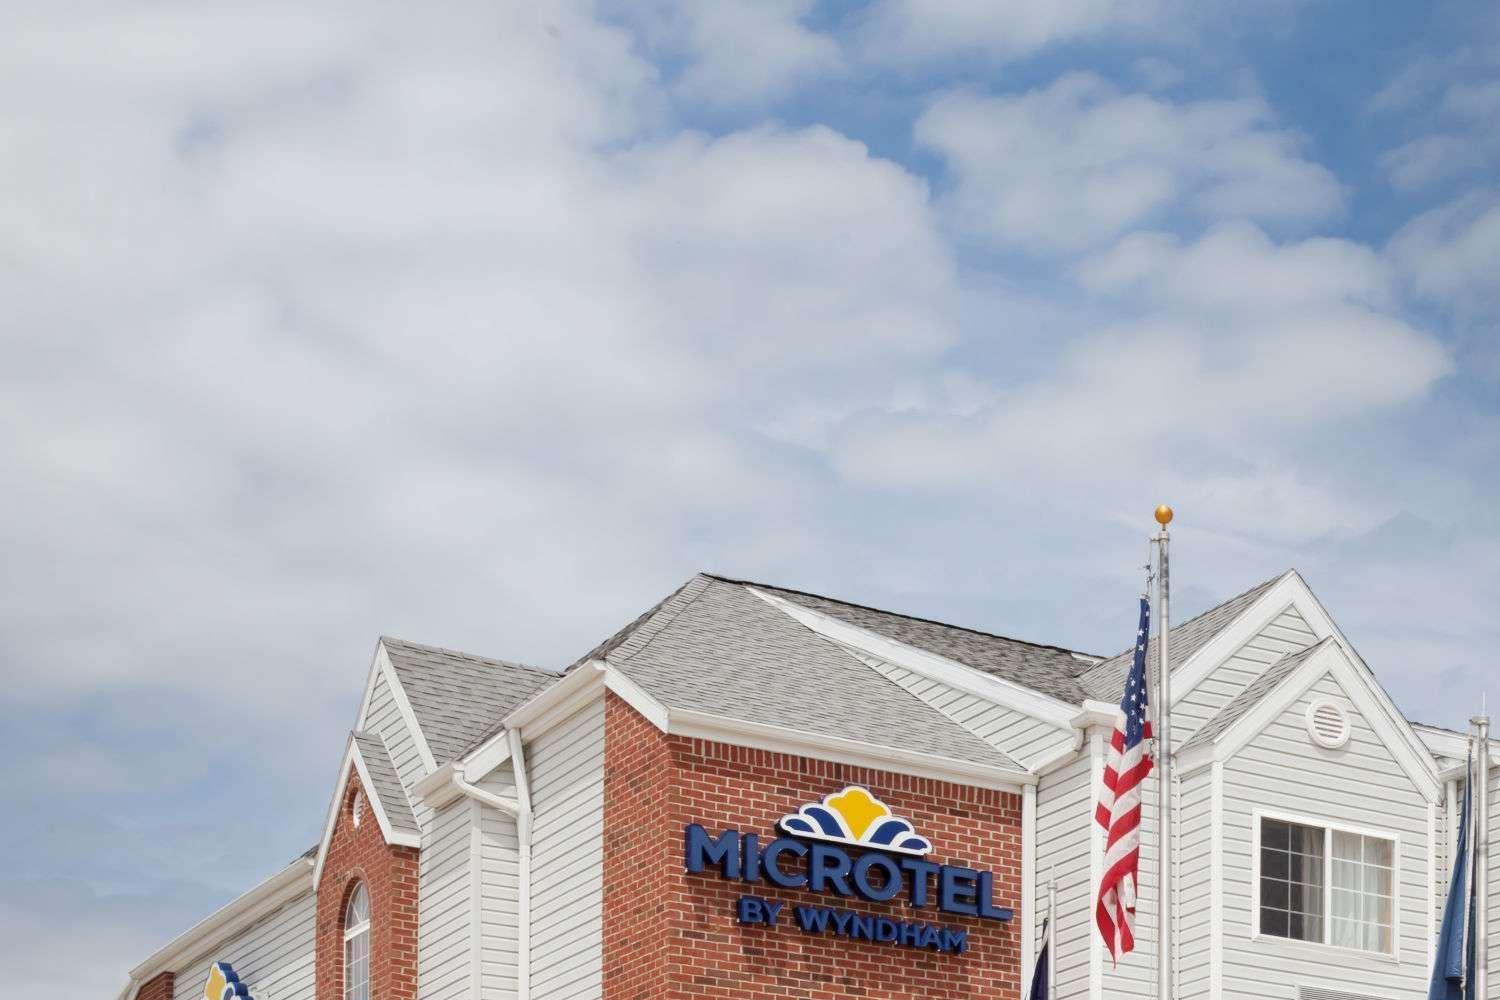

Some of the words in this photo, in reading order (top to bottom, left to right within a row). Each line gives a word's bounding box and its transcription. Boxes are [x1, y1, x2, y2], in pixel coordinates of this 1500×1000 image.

[685, 822, 1014, 921] MICROTEL
[738, 895, 784, 926] BY
[796, 905, 969, 954] WYNDHAM
